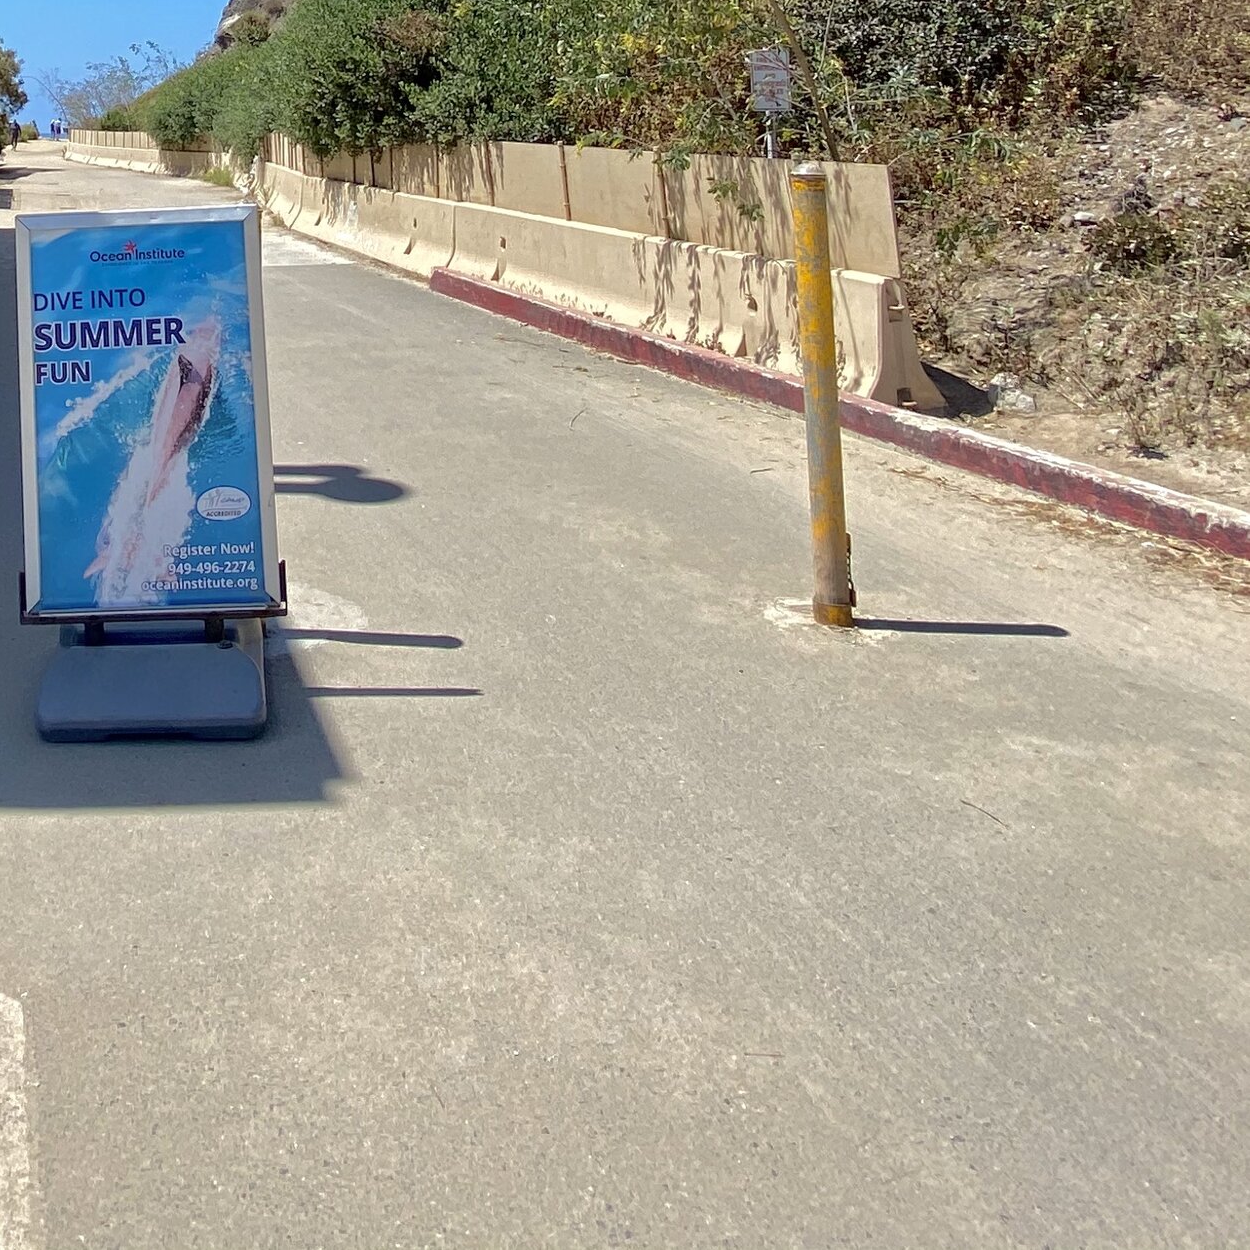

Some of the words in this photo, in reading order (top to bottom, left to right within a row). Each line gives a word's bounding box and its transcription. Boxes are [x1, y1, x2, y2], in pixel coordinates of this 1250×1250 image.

[90, 251, 132, 262] Ocean
[135, 248, 185, 260] Institute
[34, 291, 83, 311] DIVE
[91, 288, 146, 309] INTO
[34, 318, 187, 351] SUMMER
[36, 361, 91, 384] FUN
[164, 543, 217, 559] Register
[220, 541, 255, 555] Now!
[168, 561, 255, 575] 949-496-2274
[141, 577, 258, 591] oceaninstitute.org
